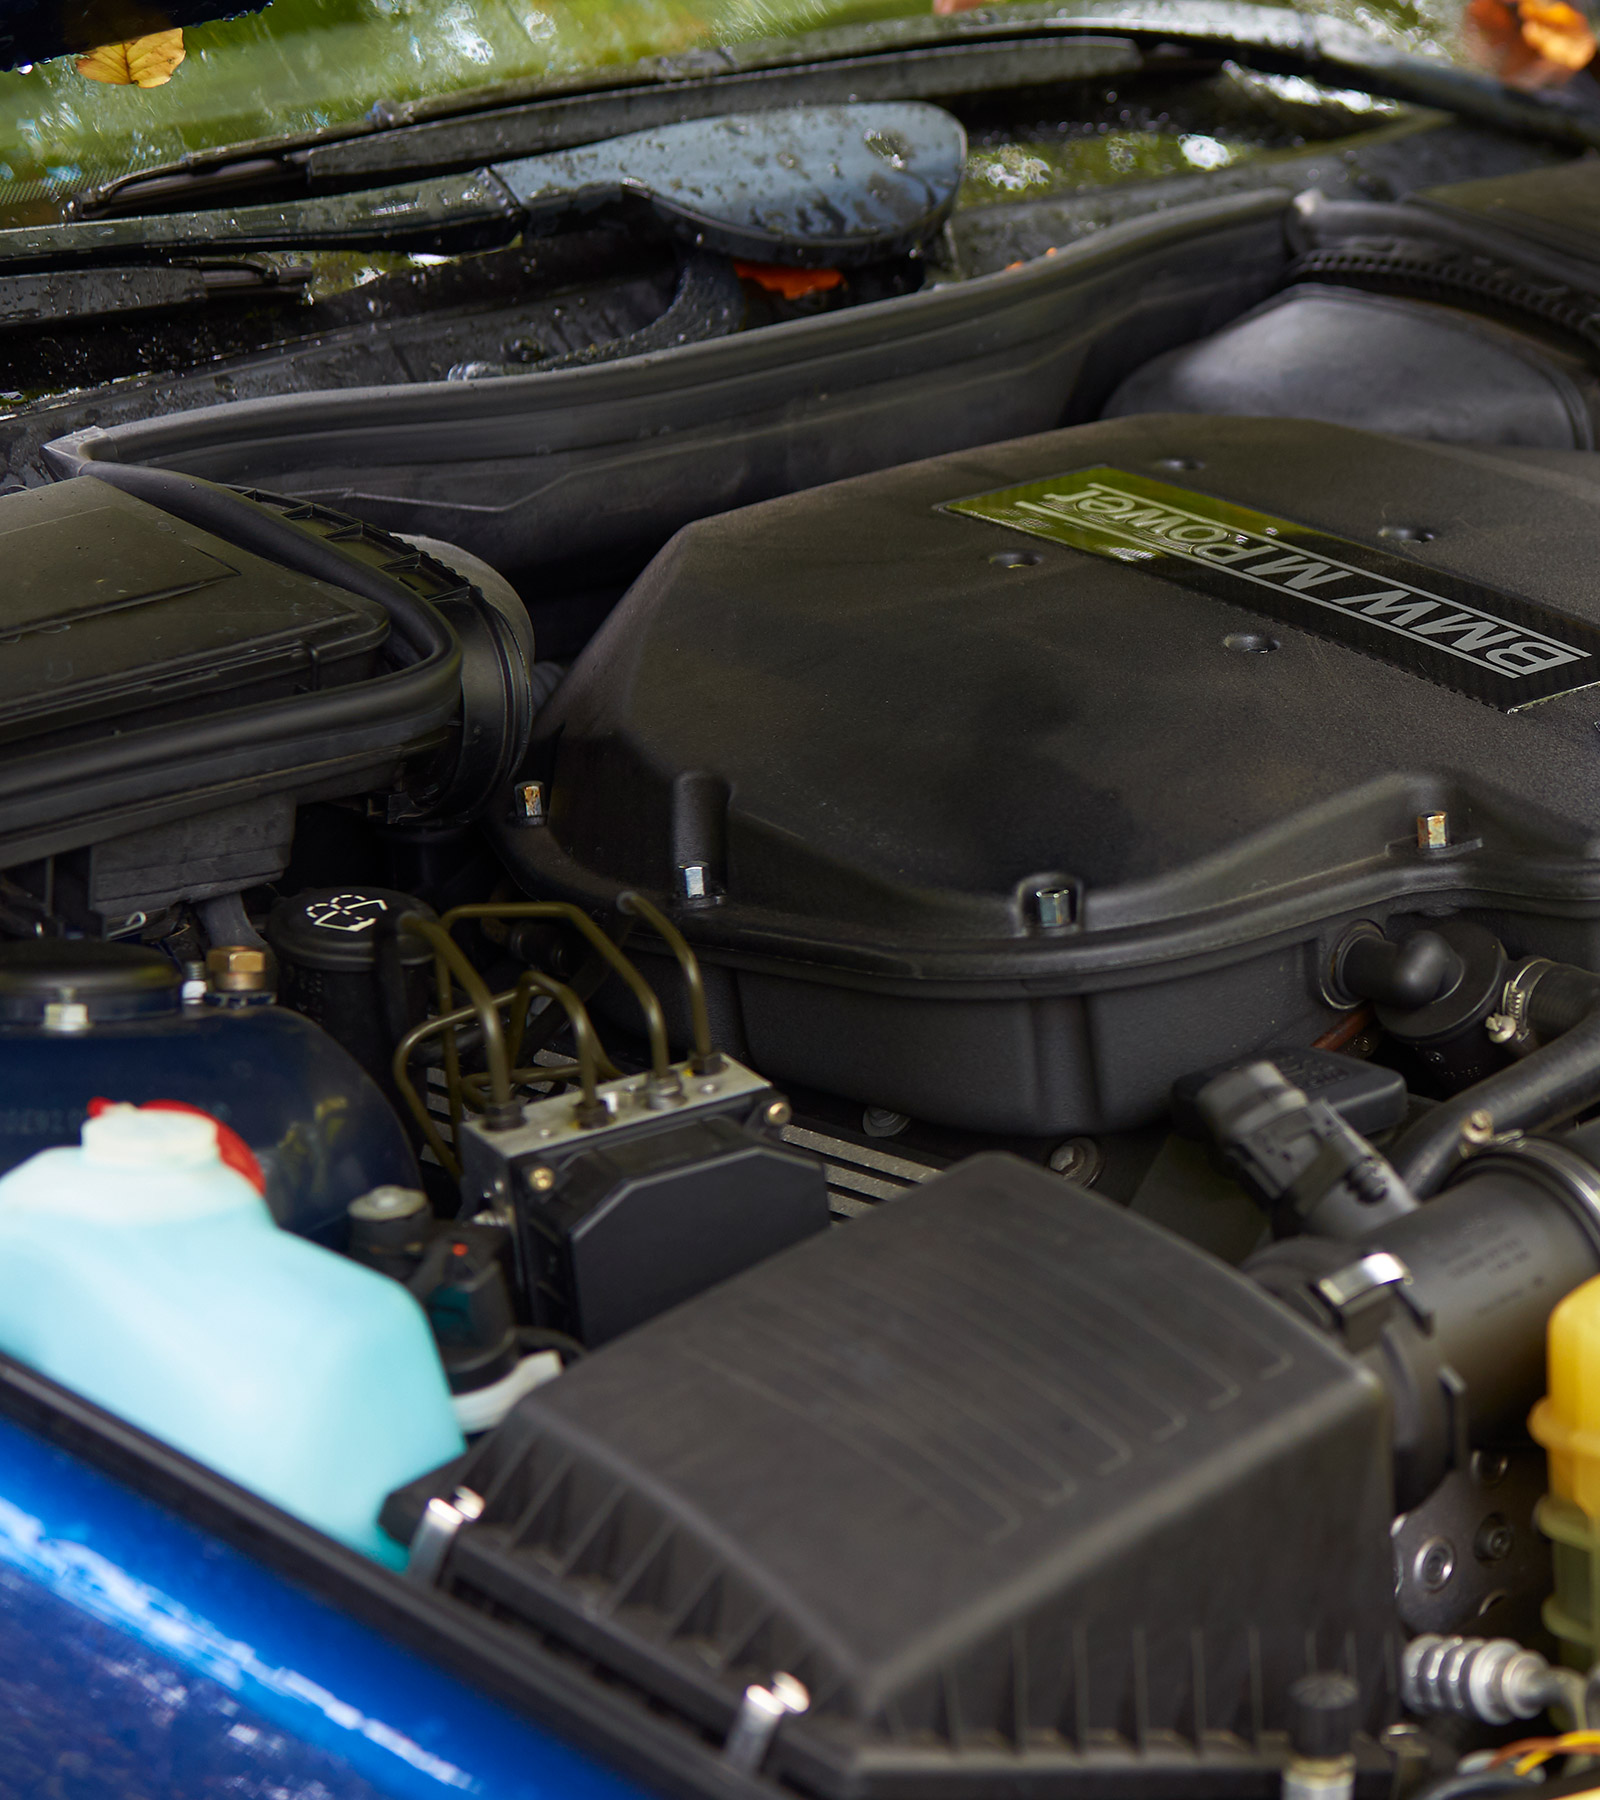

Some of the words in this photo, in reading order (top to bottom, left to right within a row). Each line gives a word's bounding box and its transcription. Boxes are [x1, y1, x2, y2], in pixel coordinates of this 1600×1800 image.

[1042, 489, 1280, 565] Power
[1242, 554, 1354, 590] M
[1331, 588, 1581, 676] BMW
